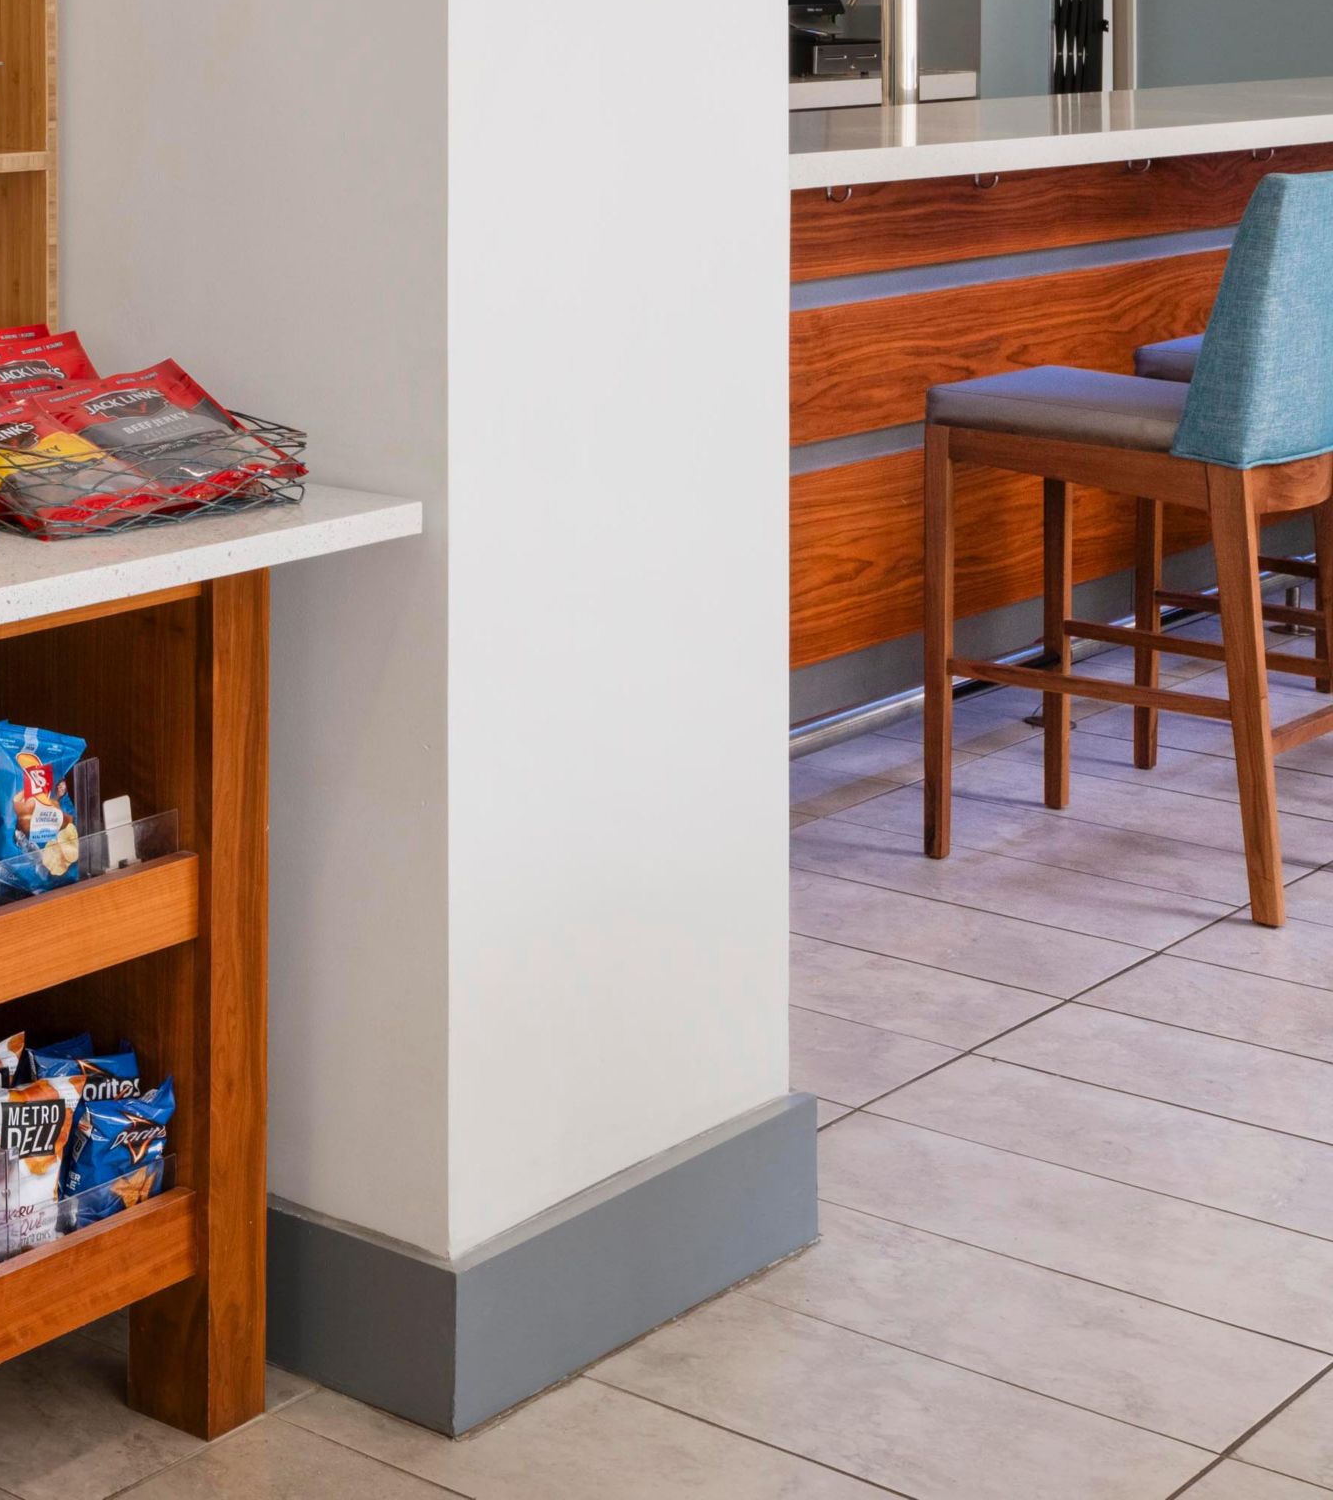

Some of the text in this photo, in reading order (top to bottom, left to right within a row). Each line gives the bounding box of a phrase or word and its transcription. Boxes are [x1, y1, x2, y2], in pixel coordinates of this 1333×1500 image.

[86, 398, 120, 415] JACK
[122, 411, 190, 435] BEEF JERKY
[83, 1078, 140, 1102] oritos
[8, 1105, 59, 1126] METRO
